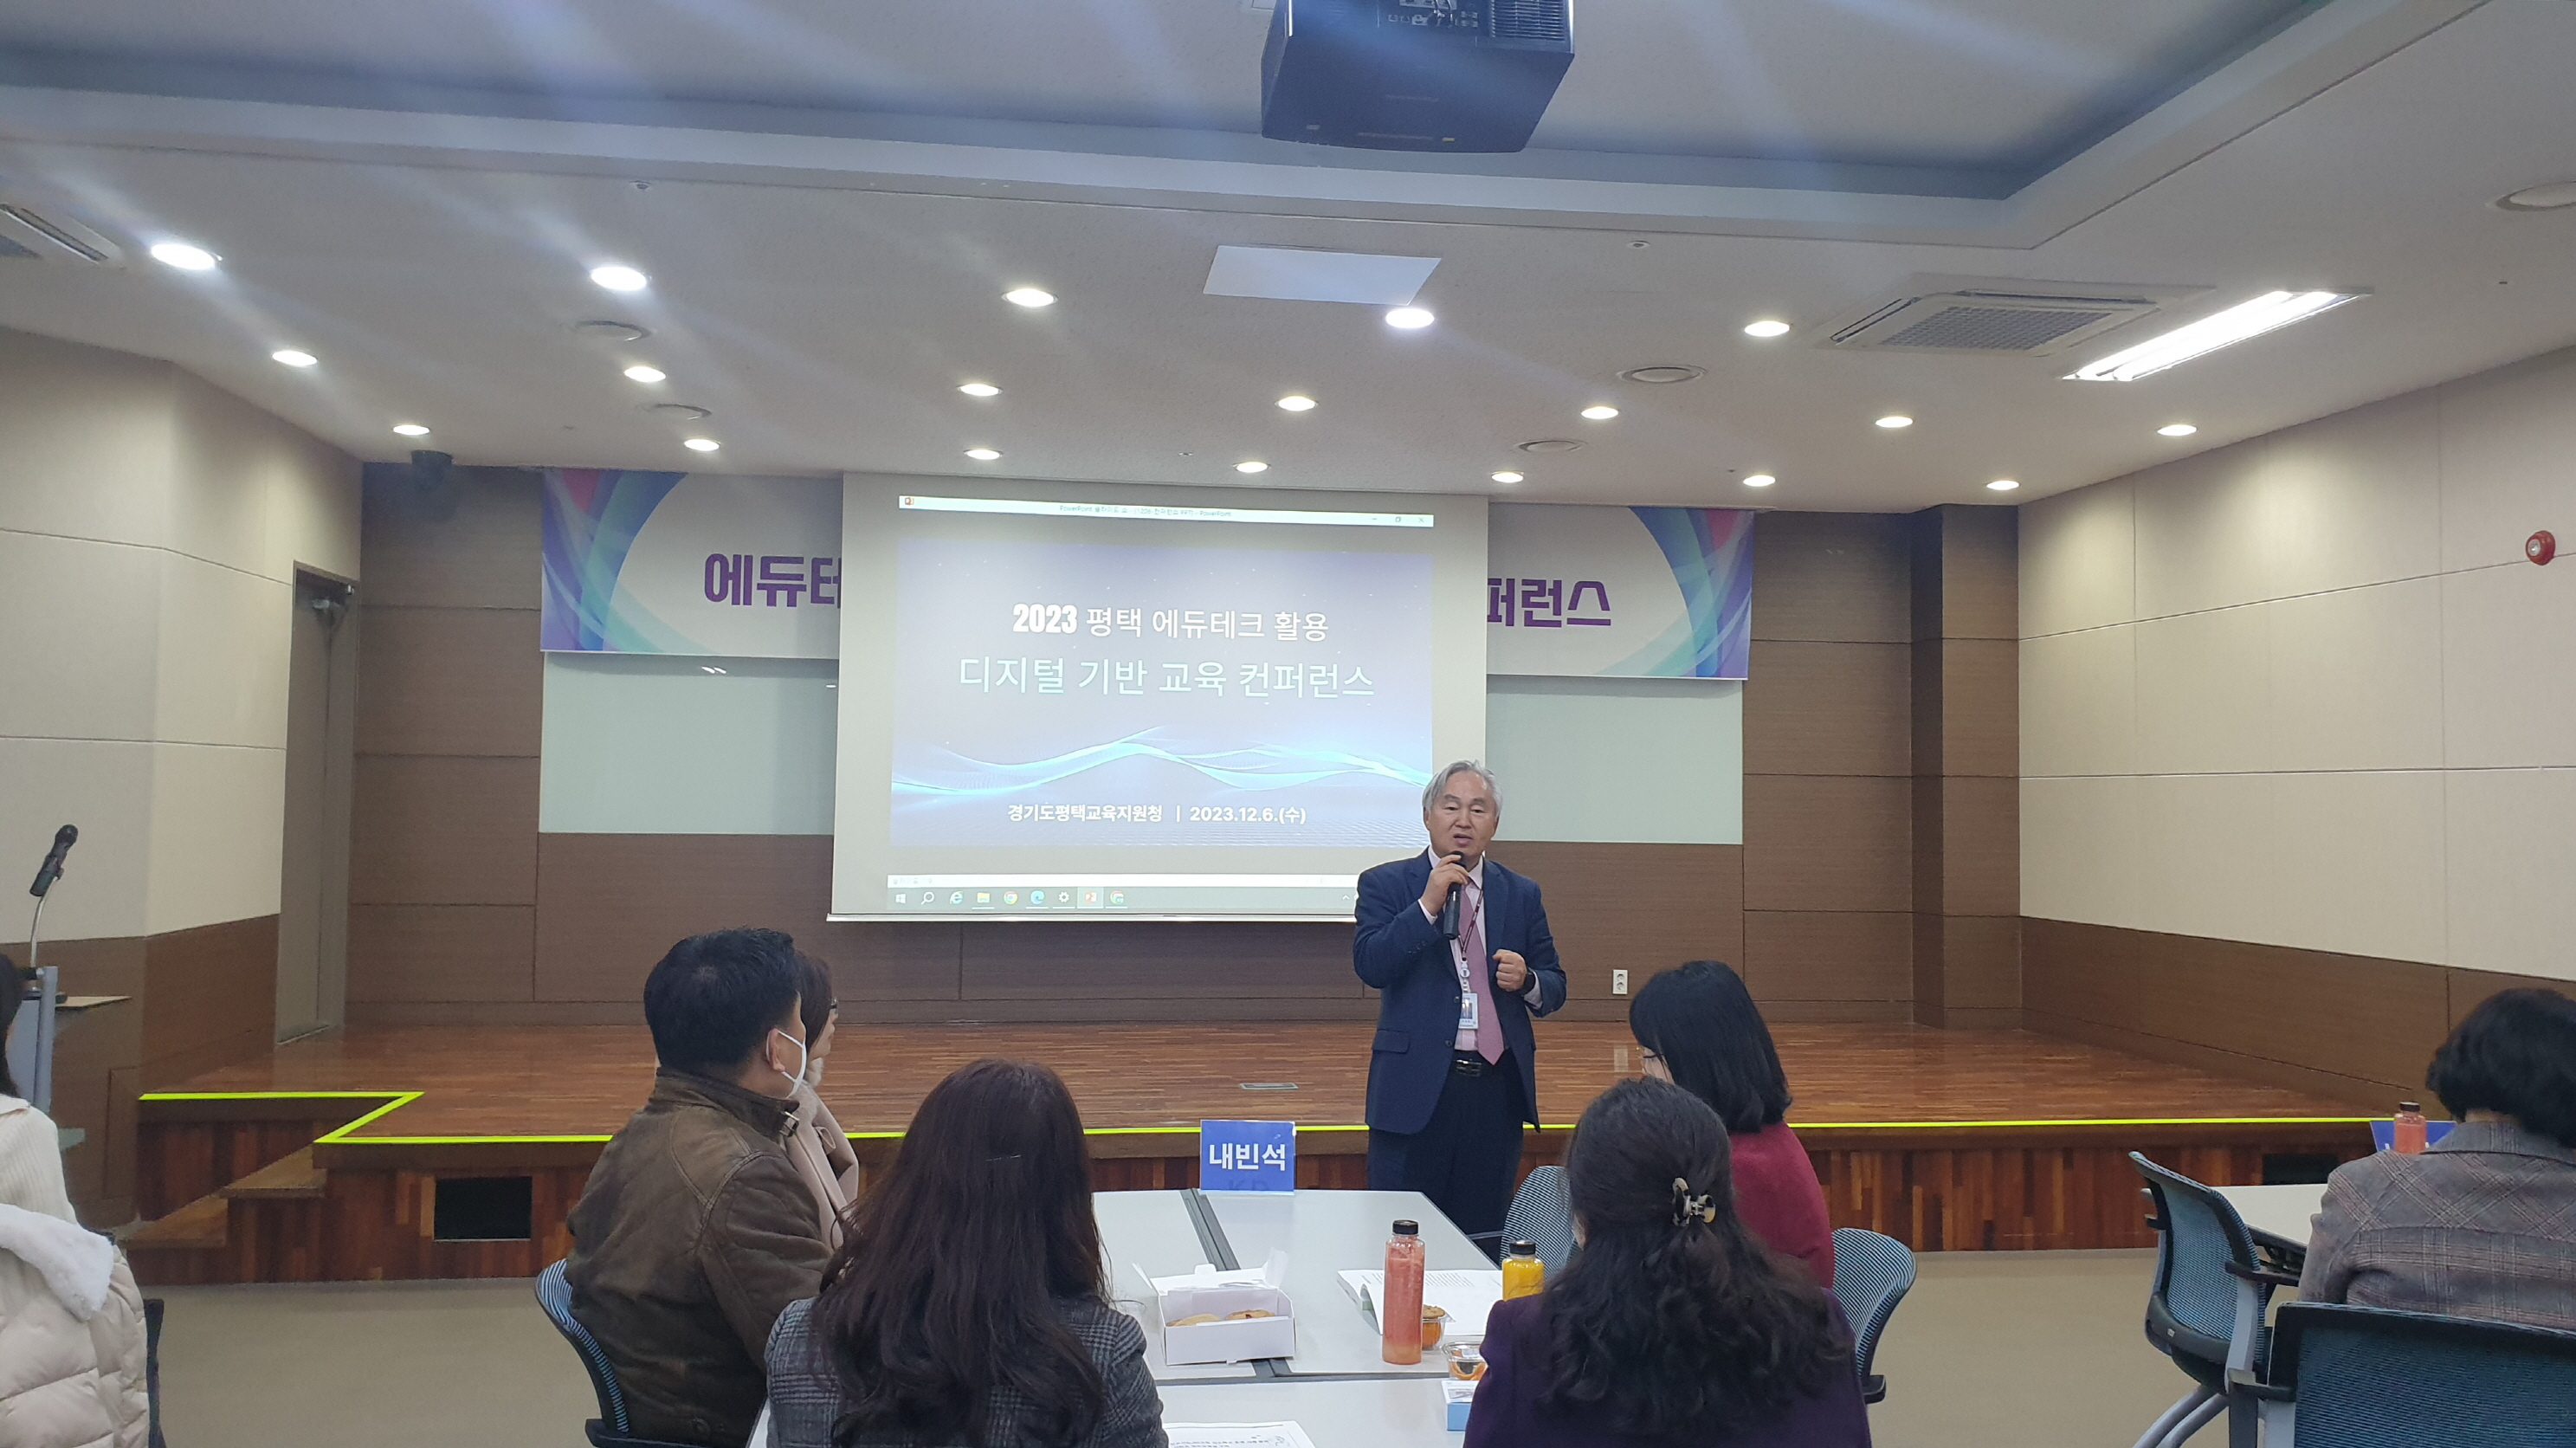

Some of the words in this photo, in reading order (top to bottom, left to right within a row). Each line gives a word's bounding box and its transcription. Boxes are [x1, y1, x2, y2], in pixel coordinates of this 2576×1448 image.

[1012, 603, 1078, 634] 2023
[1086, 607, 1141, 638] 평택
[1152, 608, 1265, 640] 에듀테크
[1274, 611, 1329, 642] 활용
[960, 656, 1064, 694] 디지털
[1078, 658, 1148, 695] 기반
[1159, 662, 1227, 697] 교육
[1239, 662, 1375, 699] 컨퍼런스
[1007, 804, 1163, 823] 경기도평택교육지원청
[1190, 806, 1307, 824] 2023.12.6.(수)
[1209, 1142, 1286, 1171] 내빈석
